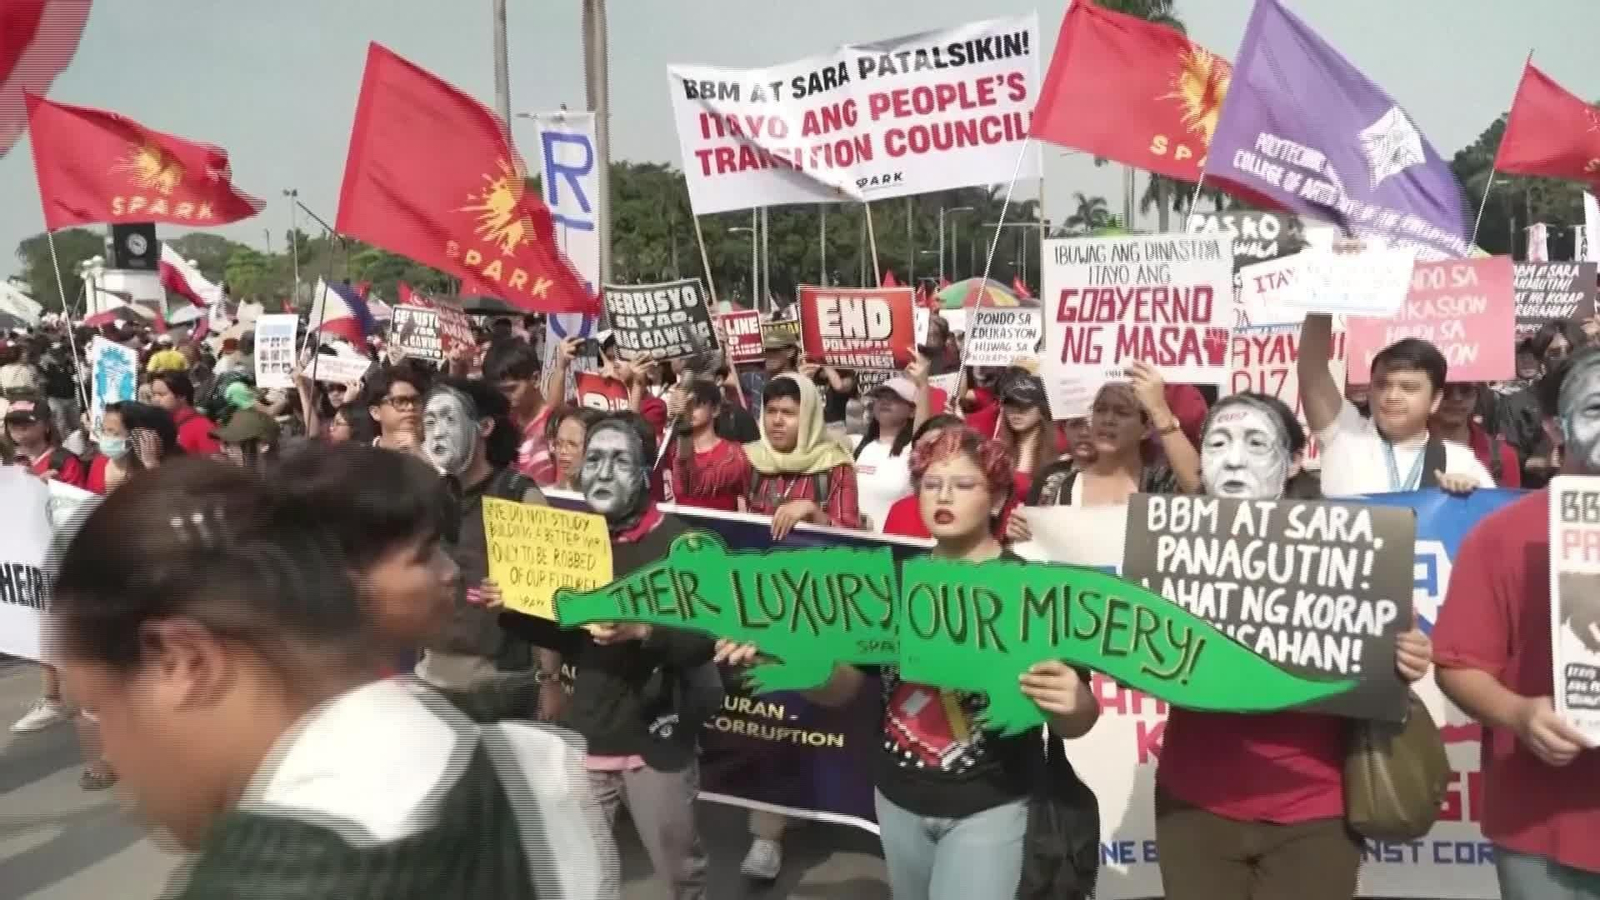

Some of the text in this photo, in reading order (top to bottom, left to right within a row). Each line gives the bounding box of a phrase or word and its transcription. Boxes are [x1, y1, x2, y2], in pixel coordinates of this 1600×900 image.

[683, 30, 1030, 103] BBM AT SARA PATALSIKIN!
[699, 72, 1027, 140] ITAYO ANG PEOPLE'S
[695, 132, 874, 176] TRANSITION
[111, 195, 214, 220] SPARK
[1054, 244, 1107, 266] IBUWAG
[1111, 241, 1141, 264] ANG
[1088, 264, 1172, 285] ITAYO ANG
[1450, 265, 1480, 288] SA
[1547, 264, 1580, 279] SARA
[606, 286, 698, 316] SERBISYO
[1056, 284, 1214, 324] GOBYERNO
[816, 296, 893, 341] END
[976, 312, 1032, 325] PONDO SA
[1440, 319, 1466, 342] SA
[971, 327, 1037, 339] EDUKASYON
[1060, 323, 1205, 367] NG MASA
[1147, 496, 1219, 533] BBM
[1230, 500, 1277, 538] AT
[552, 547, 597, 572] ROBBED
[1157, 534, 1375, 590] PANAGUTIN!
[509, 566, 525, 586] OF
[1141, 576, 1398, 636] AHAT NG KORAP
[605, 566, 721, 620] THEIR
[907, 582, 1010, 653] OUR
[1019, 582, 1207, 685] MISERY!
[720, 694, 785, 720] URAN
